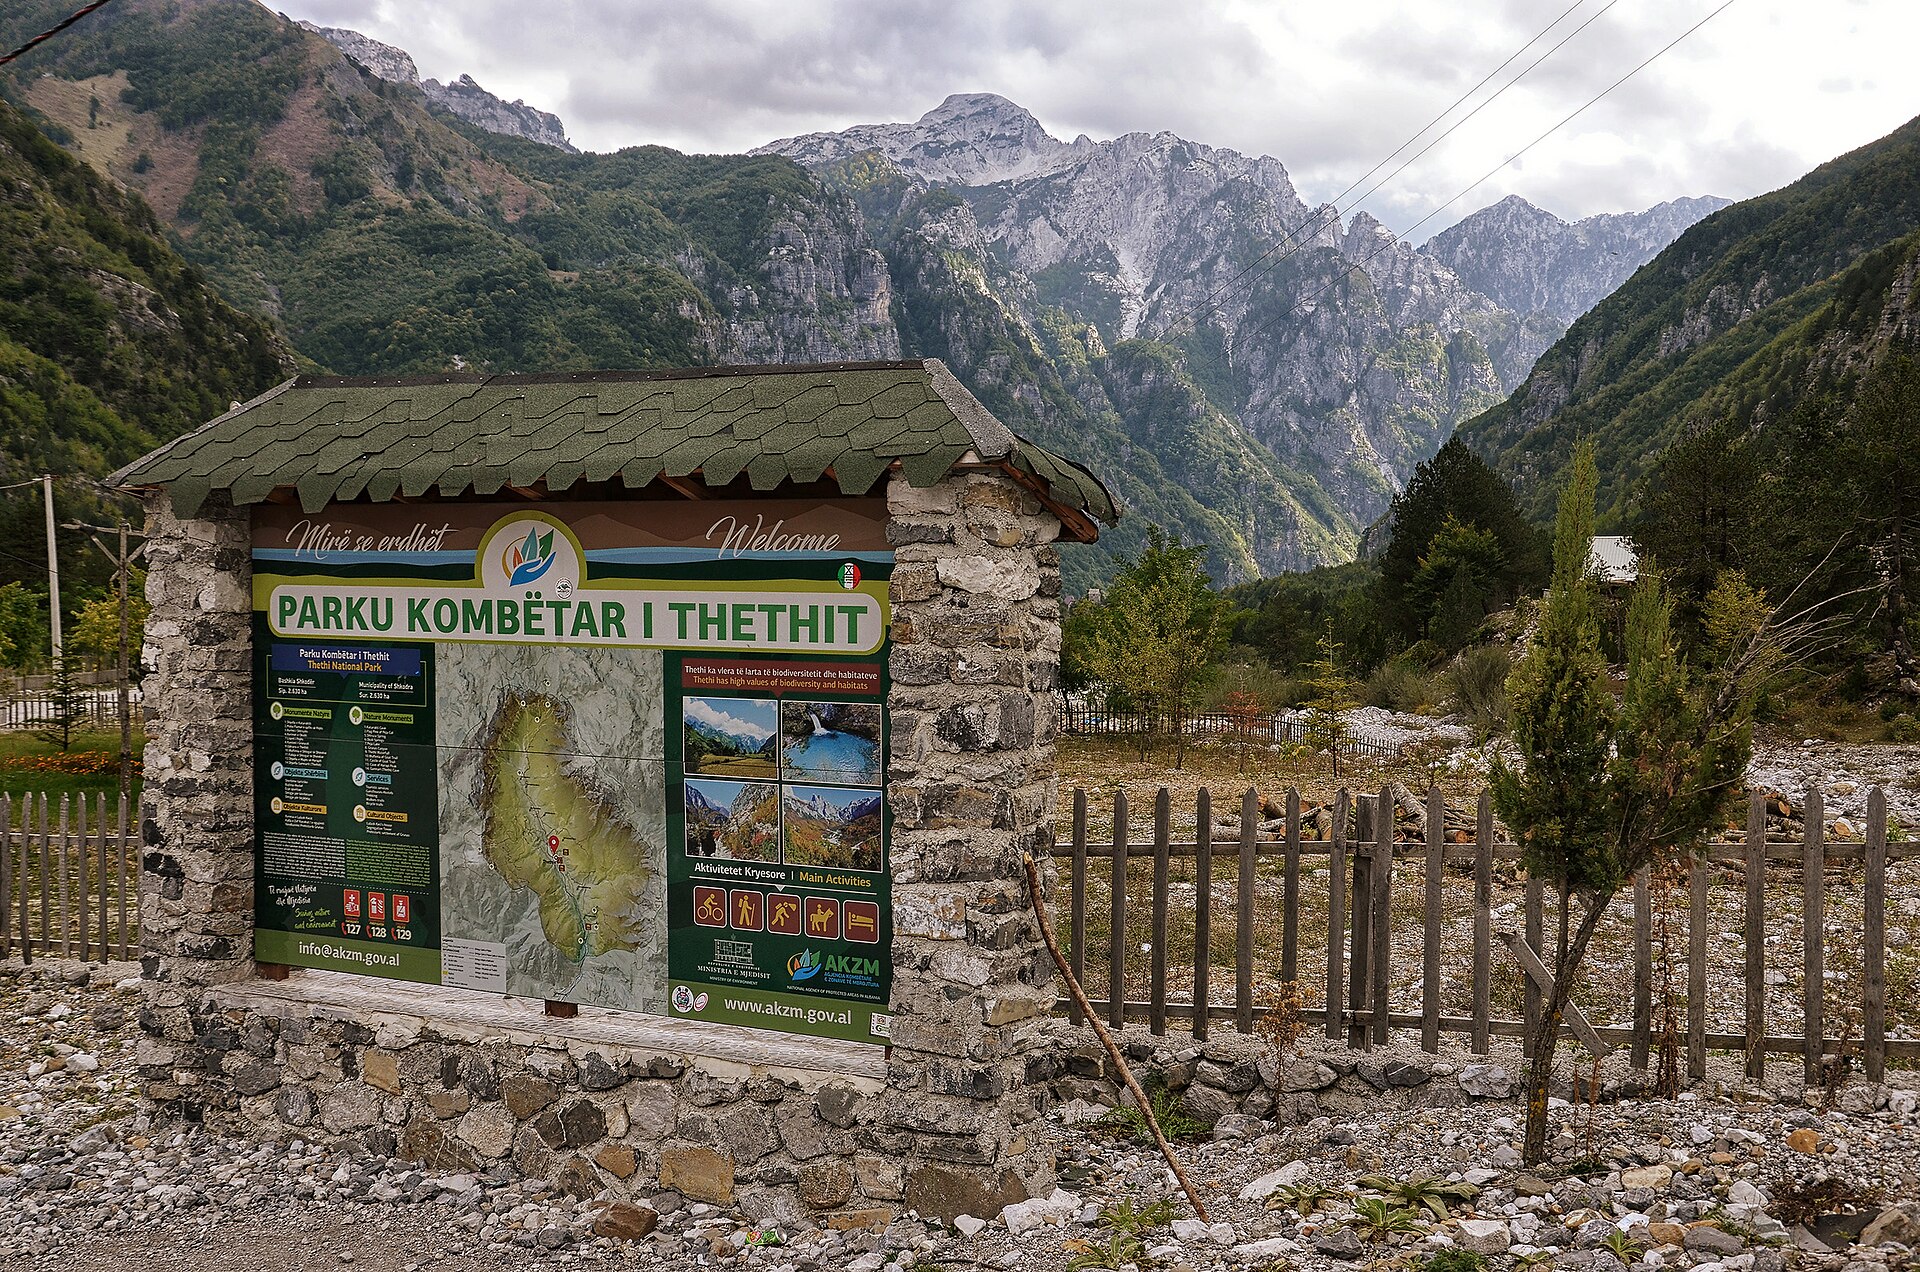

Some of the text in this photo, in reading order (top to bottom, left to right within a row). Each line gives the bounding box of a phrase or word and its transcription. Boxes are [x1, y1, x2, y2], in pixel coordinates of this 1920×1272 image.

[286, 519, 461, 560] Mirë se erdhët
[706, 514, 841, 560] Welcome
[279, 591, 868, 644] PARKU KOMBËTAR I THETHIT
[299, 648, 390, 661] Parku Kombëtar i Thethit
[308, 660, 382, 672] Thethi National Park
[685, 665, 878, 680] Thethi ka vlera të larta të biodiversitetit dhe habitateve
[694, 676, 868, 690] Thethi has high values of biodiversity and habitats
[284, 708, 312, 718] Monumente
[364, 713, 412, 722] Nature Monuments
[367, 774, 389, 783] Services
[367, 812, 404, 821] Cultural Objects
[694, 862, 872, 888] Aktivitetet Kryesore Main Activities
[346, 924, 361, 935] 127
[370, 926, 387, 938] 128
[396, 928, 412, 940] 129
[298, 942, 400, 967] info@akzm.gov.al
[697, 965, 733, 975] MINISTRIA
[740, 970, 771, 980] MJEDISIT
[824, 954, 880, 977] AKZM
[724, 997, 852, 1025] www.akzm.gov.al
